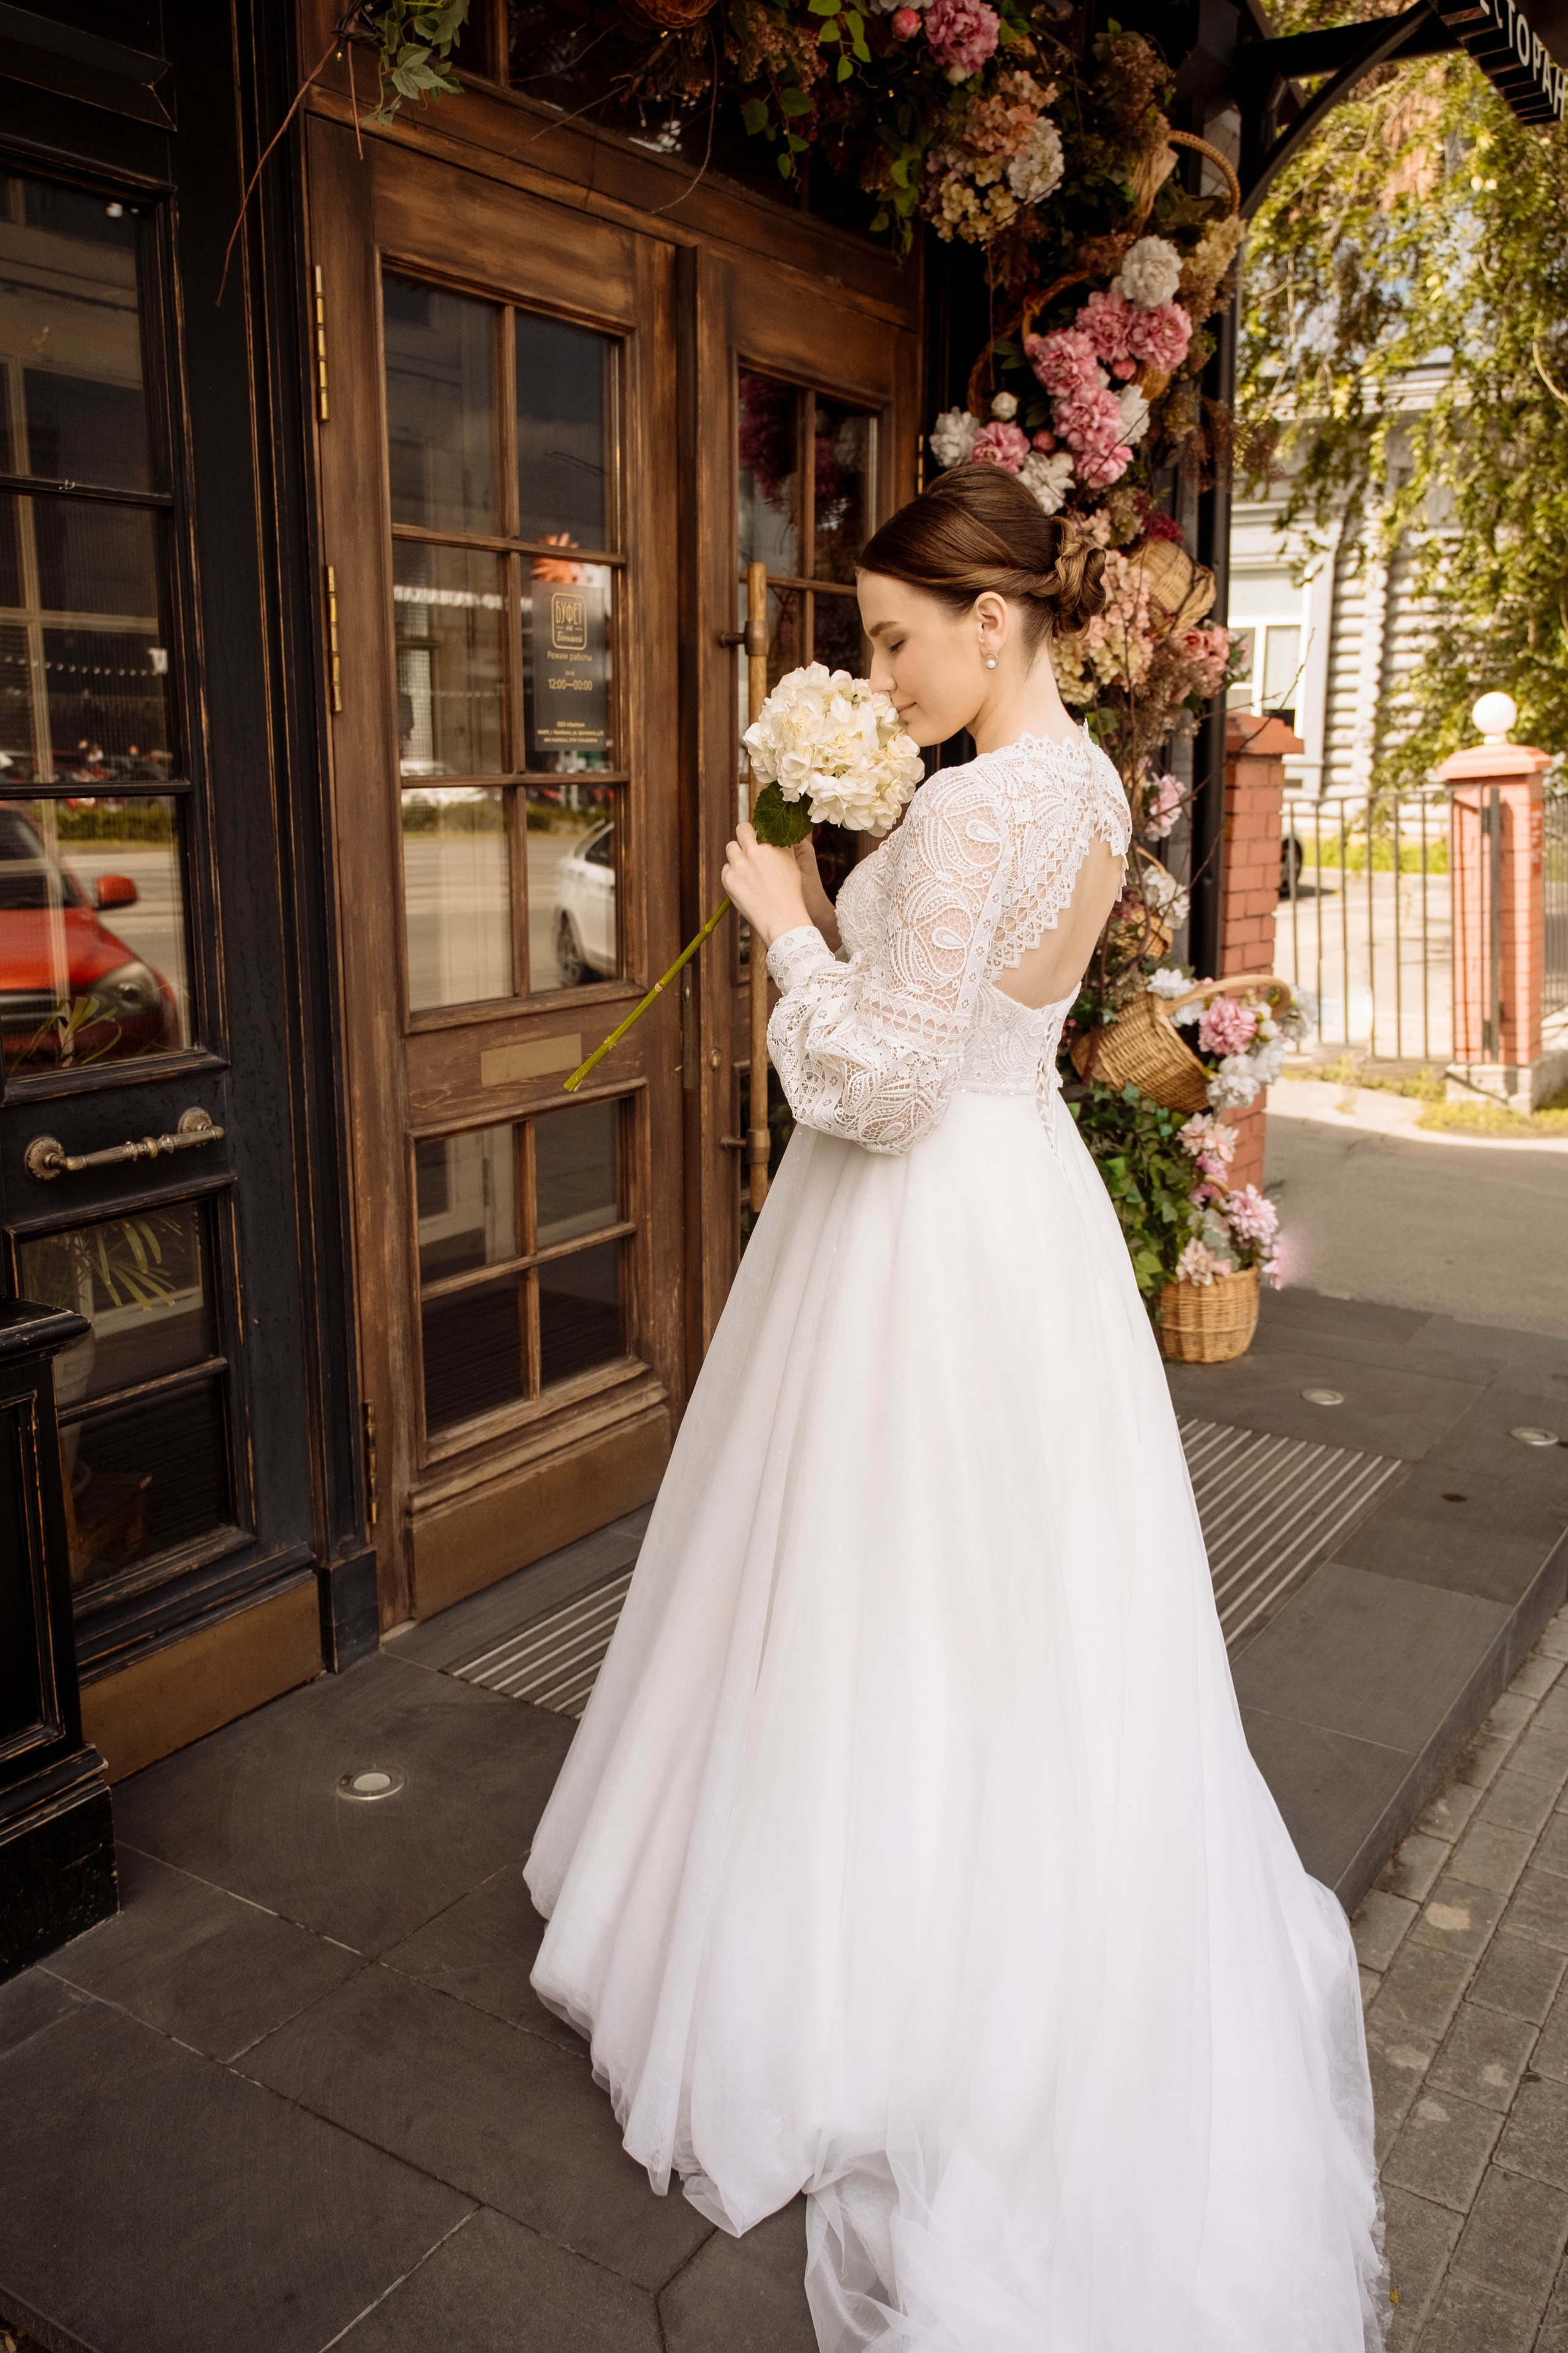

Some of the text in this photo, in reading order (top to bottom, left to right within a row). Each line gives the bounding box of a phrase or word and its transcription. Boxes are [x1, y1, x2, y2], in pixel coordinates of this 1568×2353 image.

[1480, 0, 1567, 121] СТОРАН
[556, 601, 582, 625] БУФЕТ
[547, 651, 592, 662] Режим работы
